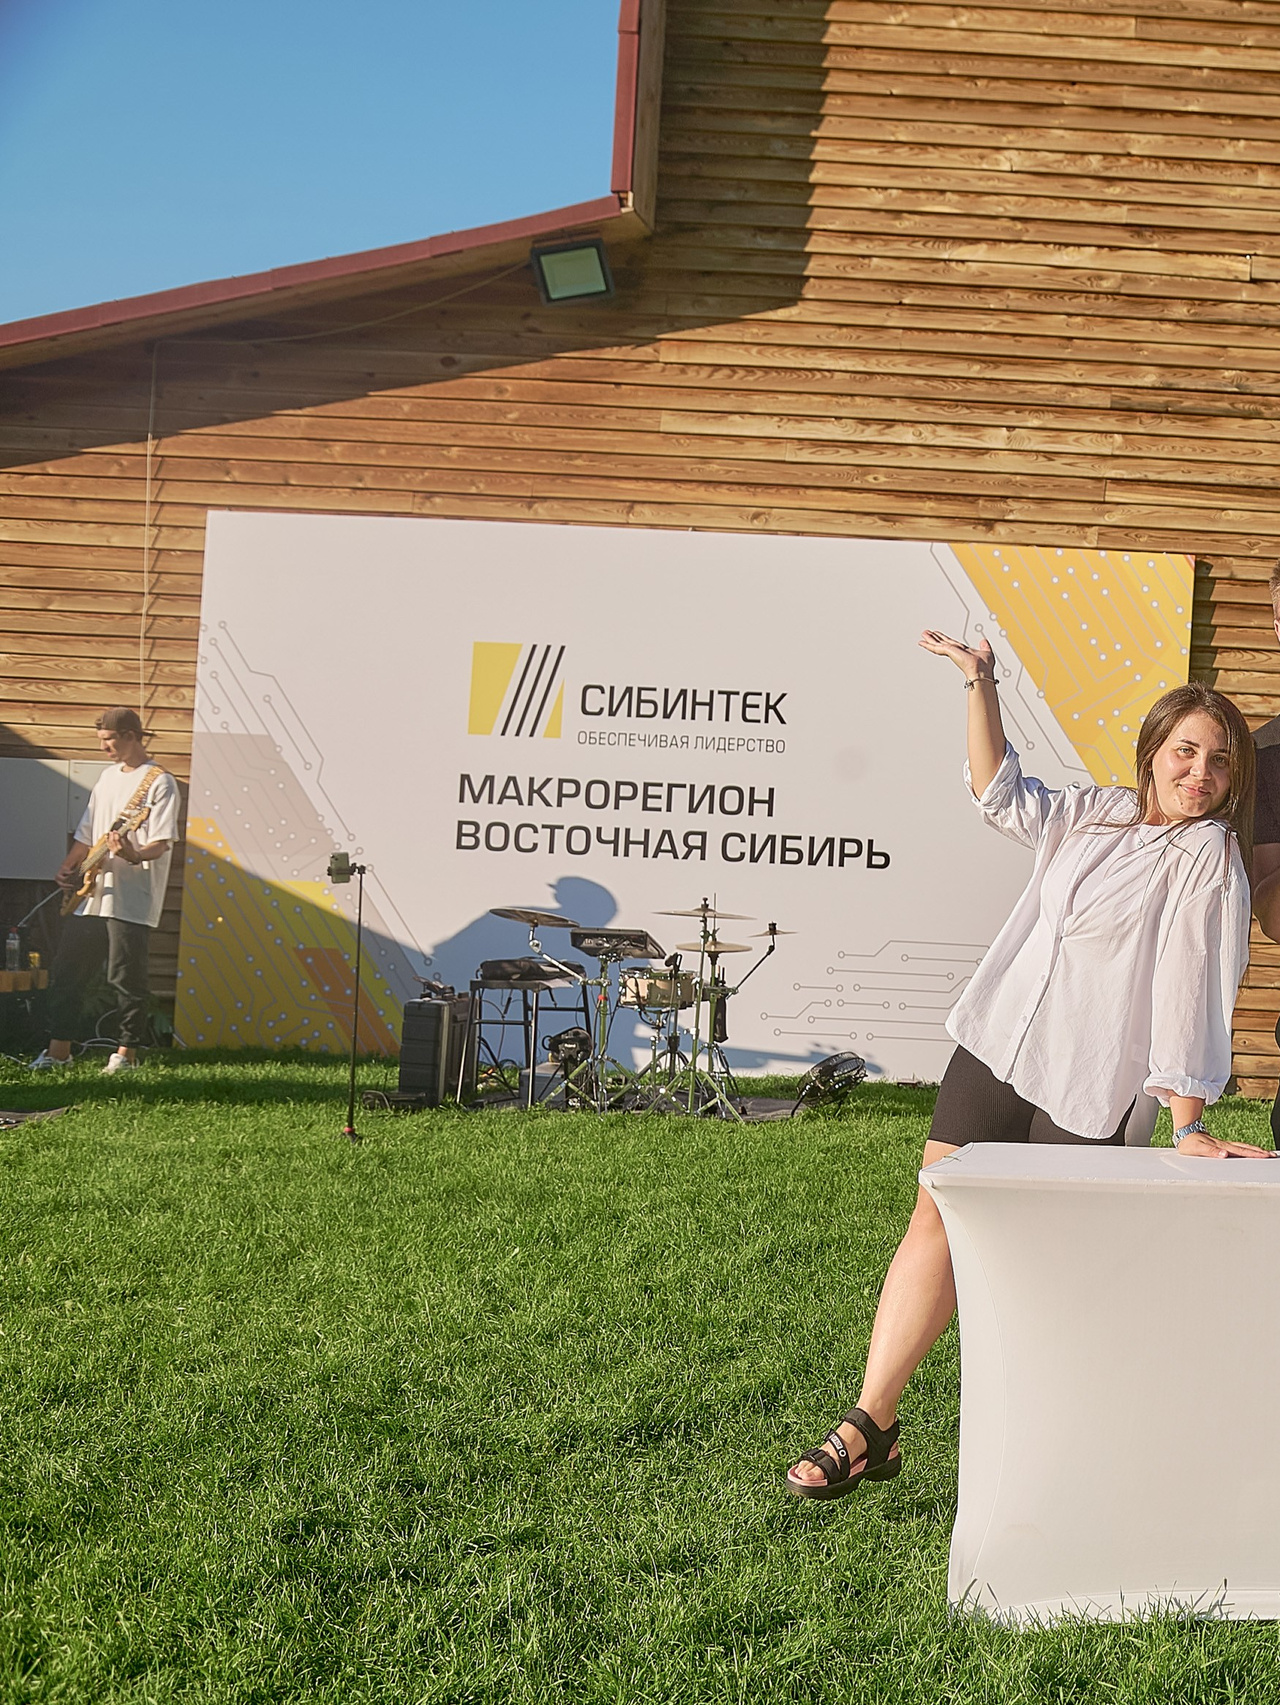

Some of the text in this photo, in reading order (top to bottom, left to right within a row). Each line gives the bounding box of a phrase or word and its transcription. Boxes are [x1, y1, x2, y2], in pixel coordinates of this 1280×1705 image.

[580, 684, 788, 725] СИБИНТЕК
[577, 730, 786, 754] ОБЕСПЕЧИВАЯ ЛИДЕРСТВО
[458, 773, 775, 818] МАКРОРЕГИОН
[455, 819, 891, 870] ВОСТОЧНАЯ СИБИРЬ
